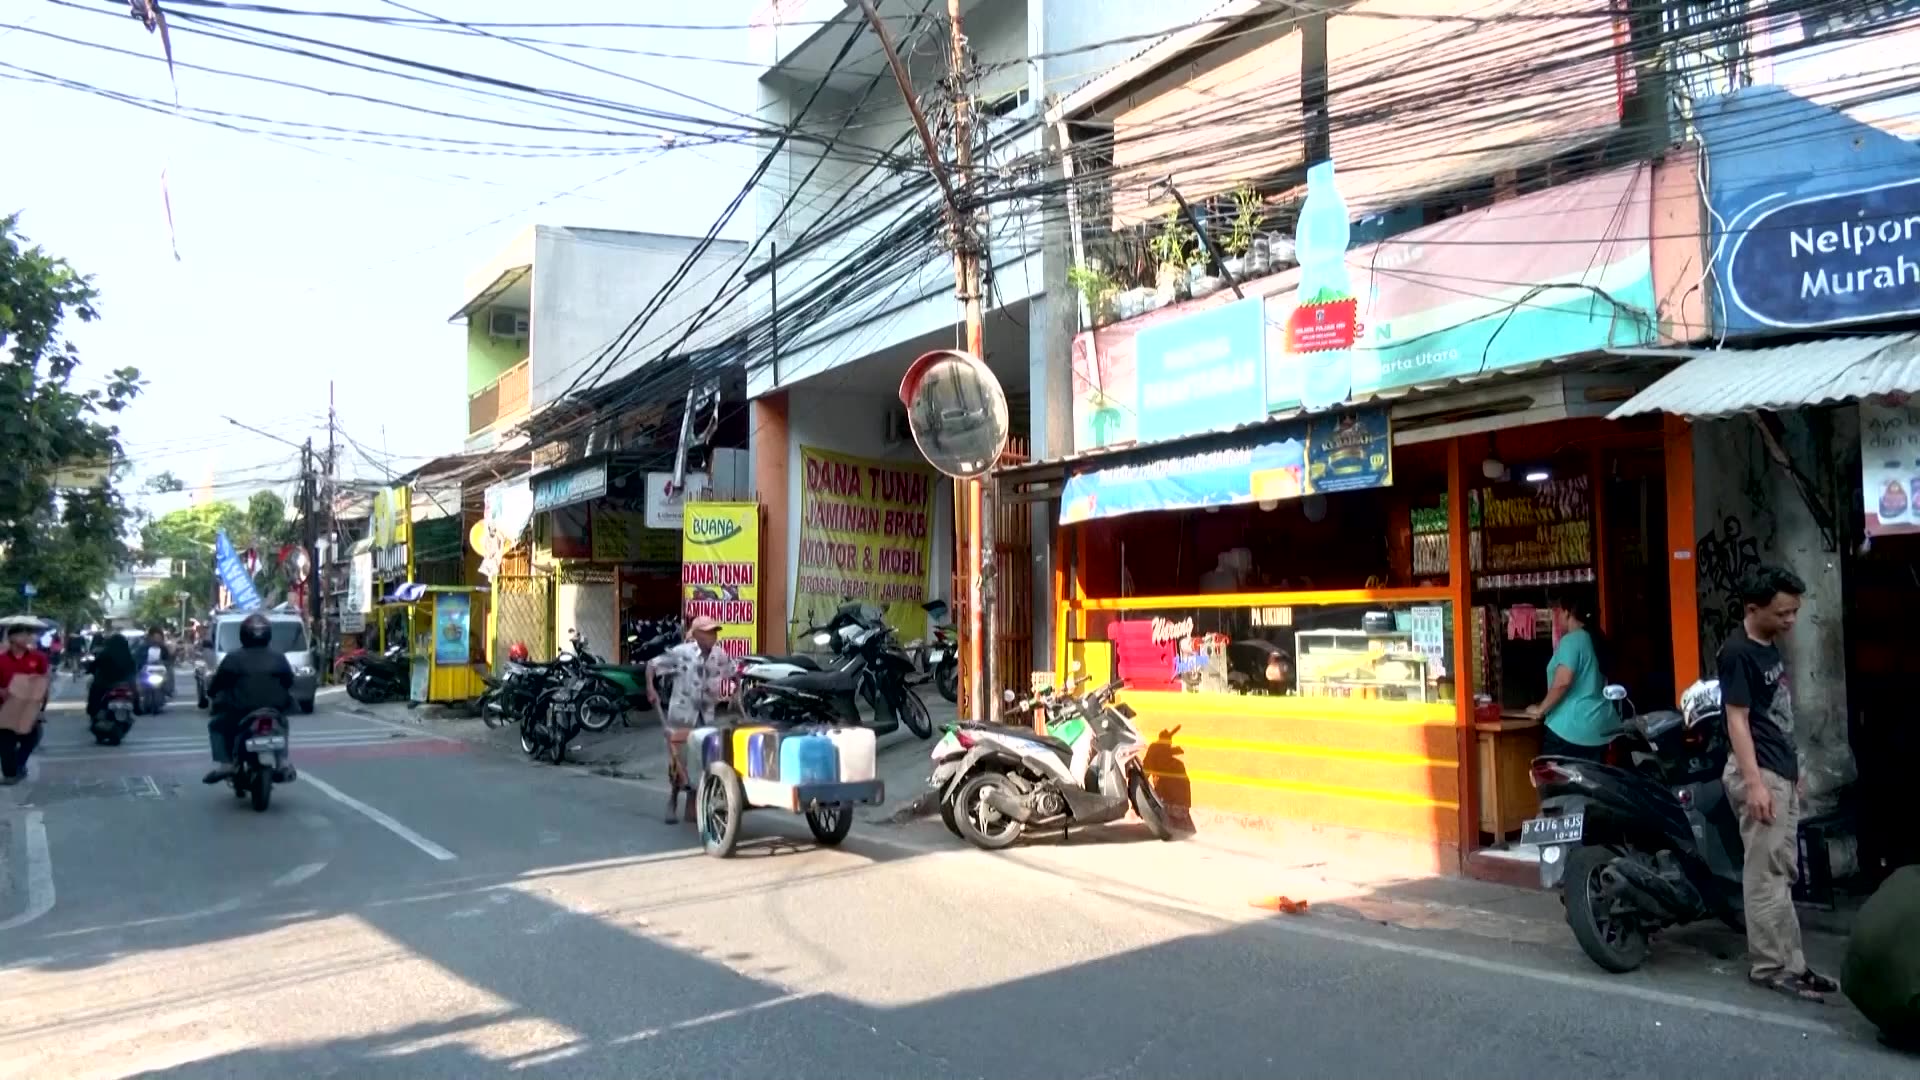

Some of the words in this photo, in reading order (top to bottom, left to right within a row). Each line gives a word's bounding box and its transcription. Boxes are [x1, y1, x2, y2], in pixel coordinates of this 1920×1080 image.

[1801, 255, 1920, 299] Murah
[1416, 347, 1458, 368] Utara
[806, 459, 861, 497] DANA
[868, 467, 929, 508] TUNAI
[693, 518, 734, 536] BUANA
[805, 499, 880, 534] JAMINAN
[883, 509, 928, 538] BPKB
[800, 539, 857, 571] MOTOR
[863, 545, 874, 574] &
[878, 546, 926, 577] MOBIL
[683, 563, 715, 586] DANA
[717, 563, 753, 586] TUNAI
[725, 601, 754, 623] BPKB
